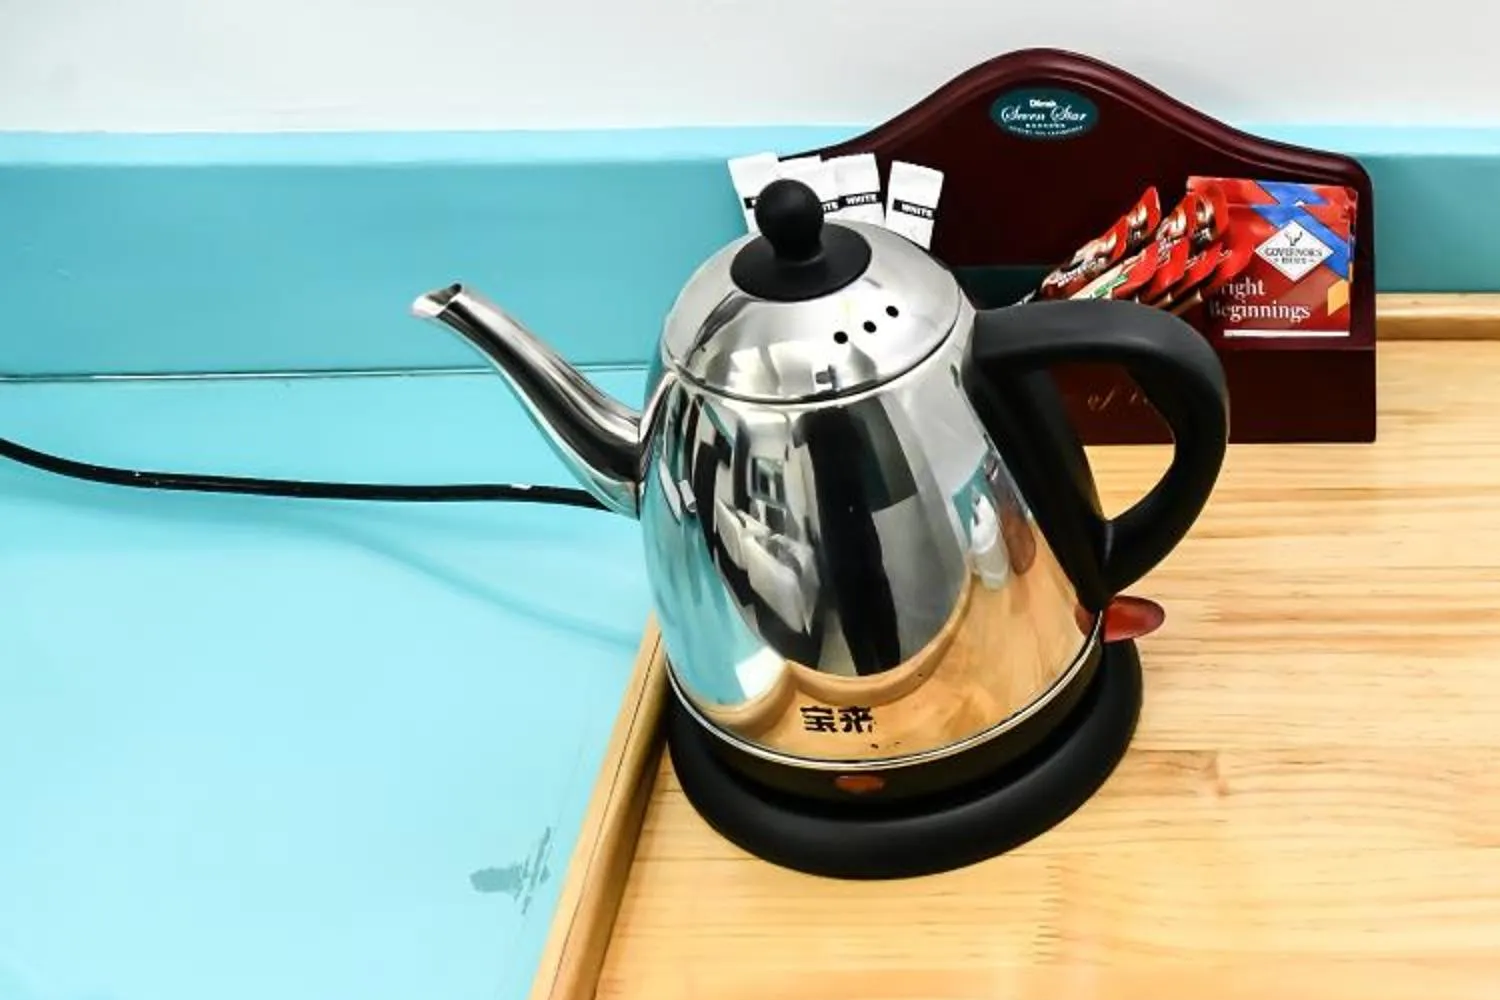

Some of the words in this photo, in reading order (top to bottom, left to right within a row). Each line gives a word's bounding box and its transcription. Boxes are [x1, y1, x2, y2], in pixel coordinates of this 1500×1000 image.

[845, 193, 878, 205] WHITE
[901, 203, 933, 219] WHITE
[1217, 275, 1267, 301] right
